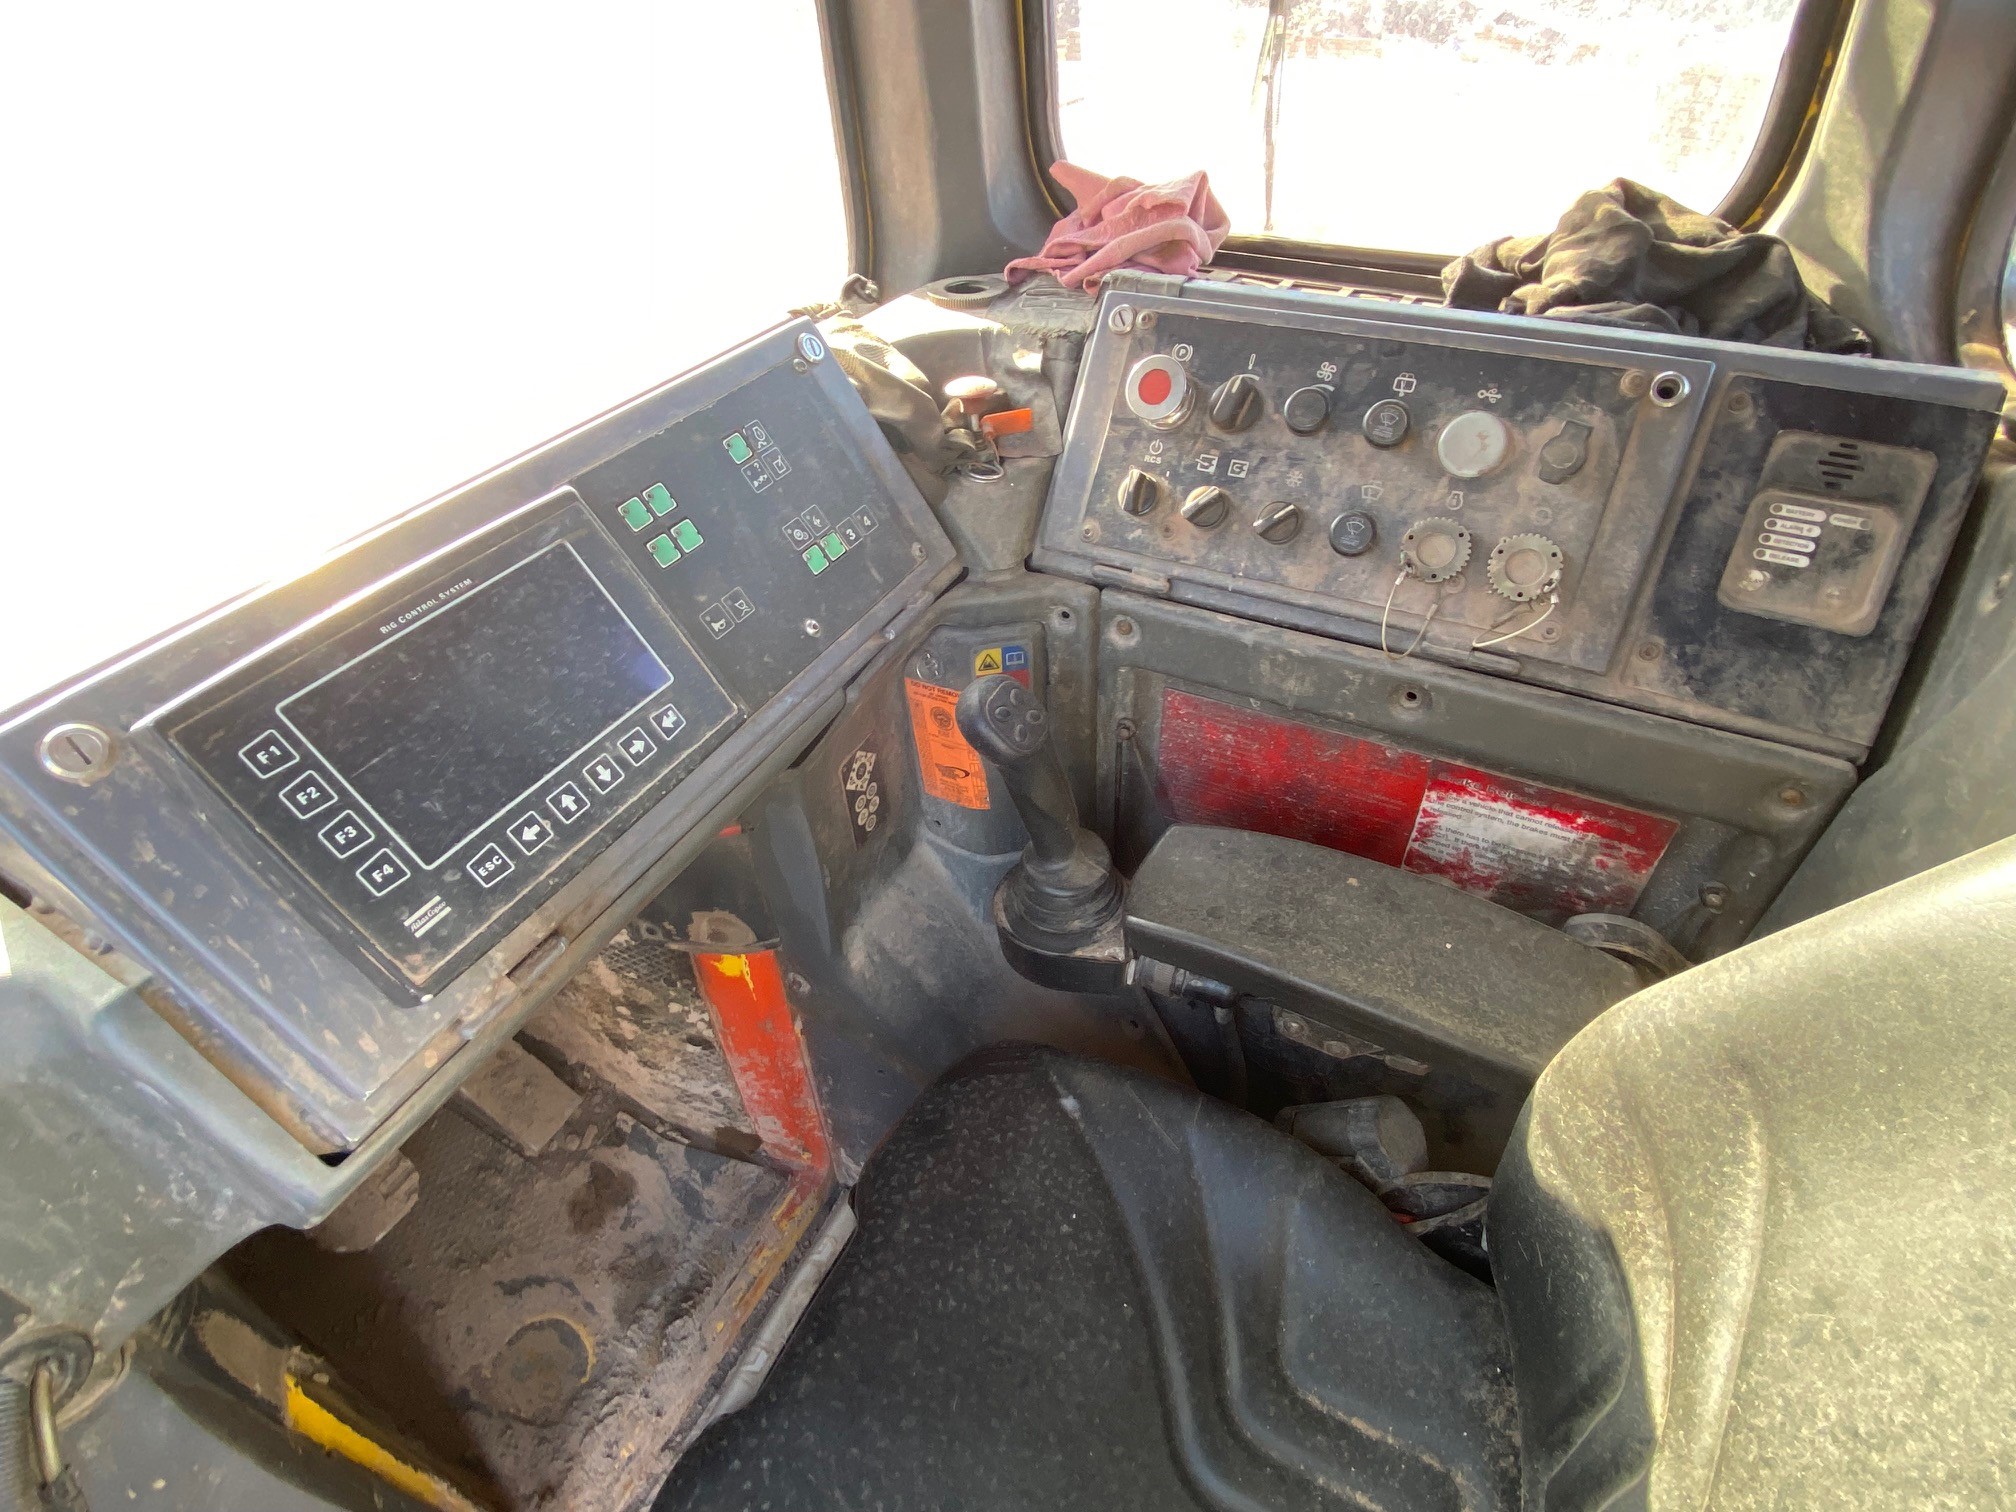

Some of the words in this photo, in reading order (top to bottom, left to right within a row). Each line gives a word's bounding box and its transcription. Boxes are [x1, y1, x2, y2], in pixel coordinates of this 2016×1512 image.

[1144, 454, 1162, 464] RCS
[863, 515, 871, 526] 4
[846, 528, 856, 540] 3
[380, 621, 398, 634] RIG
[398, 599, 439, 624] CONTROL
[438, 578, 472, 600] SYSTEM
[256, 745, 283, 764] F1
[296, 786, 321, 805] F2
[1469, 799, 1496, 812] vehicle
[1498, 808, 1513, 818] that
[1515, 813, 1543, 826] cannot
[1446, 802, 1473, 814] control
[1507, 819, 1519, 828] the
[1521, 823, 1548, 837] brakes
[1550, 832, 1571, 843] must
[335, 825, 358, 844] F3
[371, 863, 394, 883] F4
[478, 855, 502, 877] ESC
[410, 914, 429, 932] Atlas
[427, 901, 446, 918] Copco
